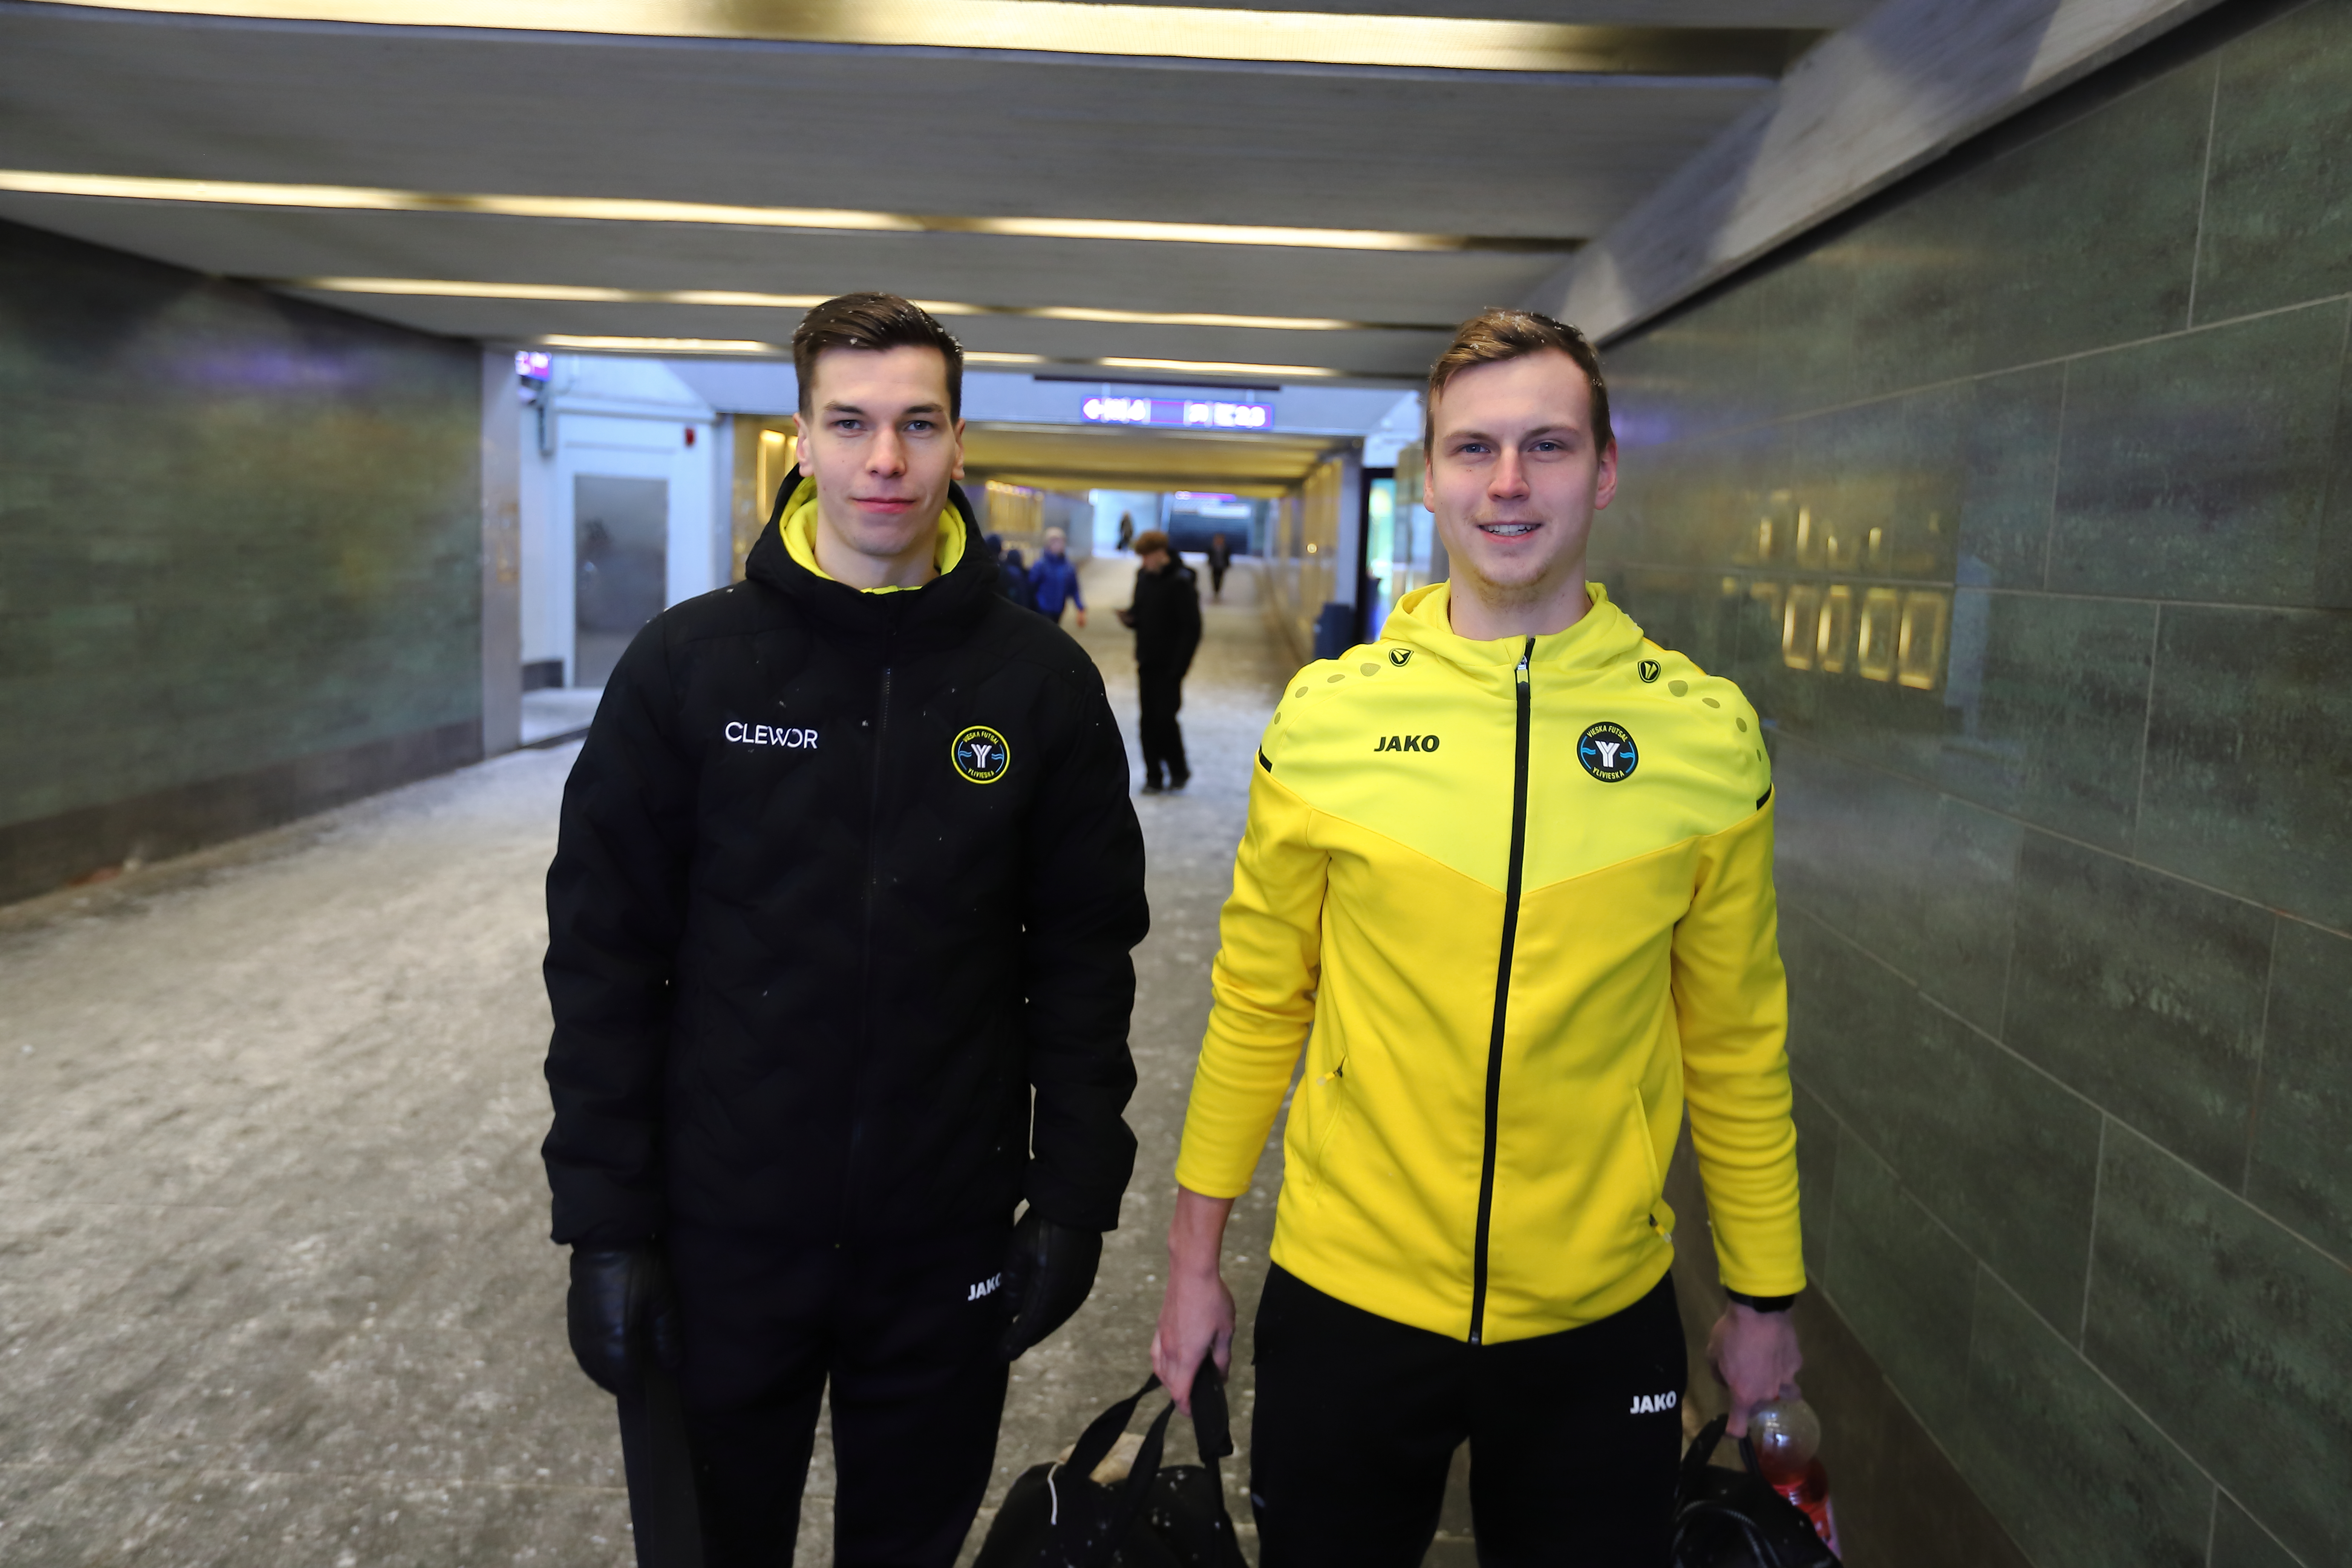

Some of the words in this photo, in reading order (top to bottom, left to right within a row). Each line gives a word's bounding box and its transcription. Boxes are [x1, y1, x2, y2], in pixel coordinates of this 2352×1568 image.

[725, 721, 818, 749] CLEWOR
[1586, 725, 1607, 738] VIESKA
[1608, 726, 1628, 742] FUTSAL
[1374, 735, 1440, 752] JAKO
[1592, 767, 1625, 779] YLIVIESKA
[1630, 1390, 1677, 1414] JAKO
